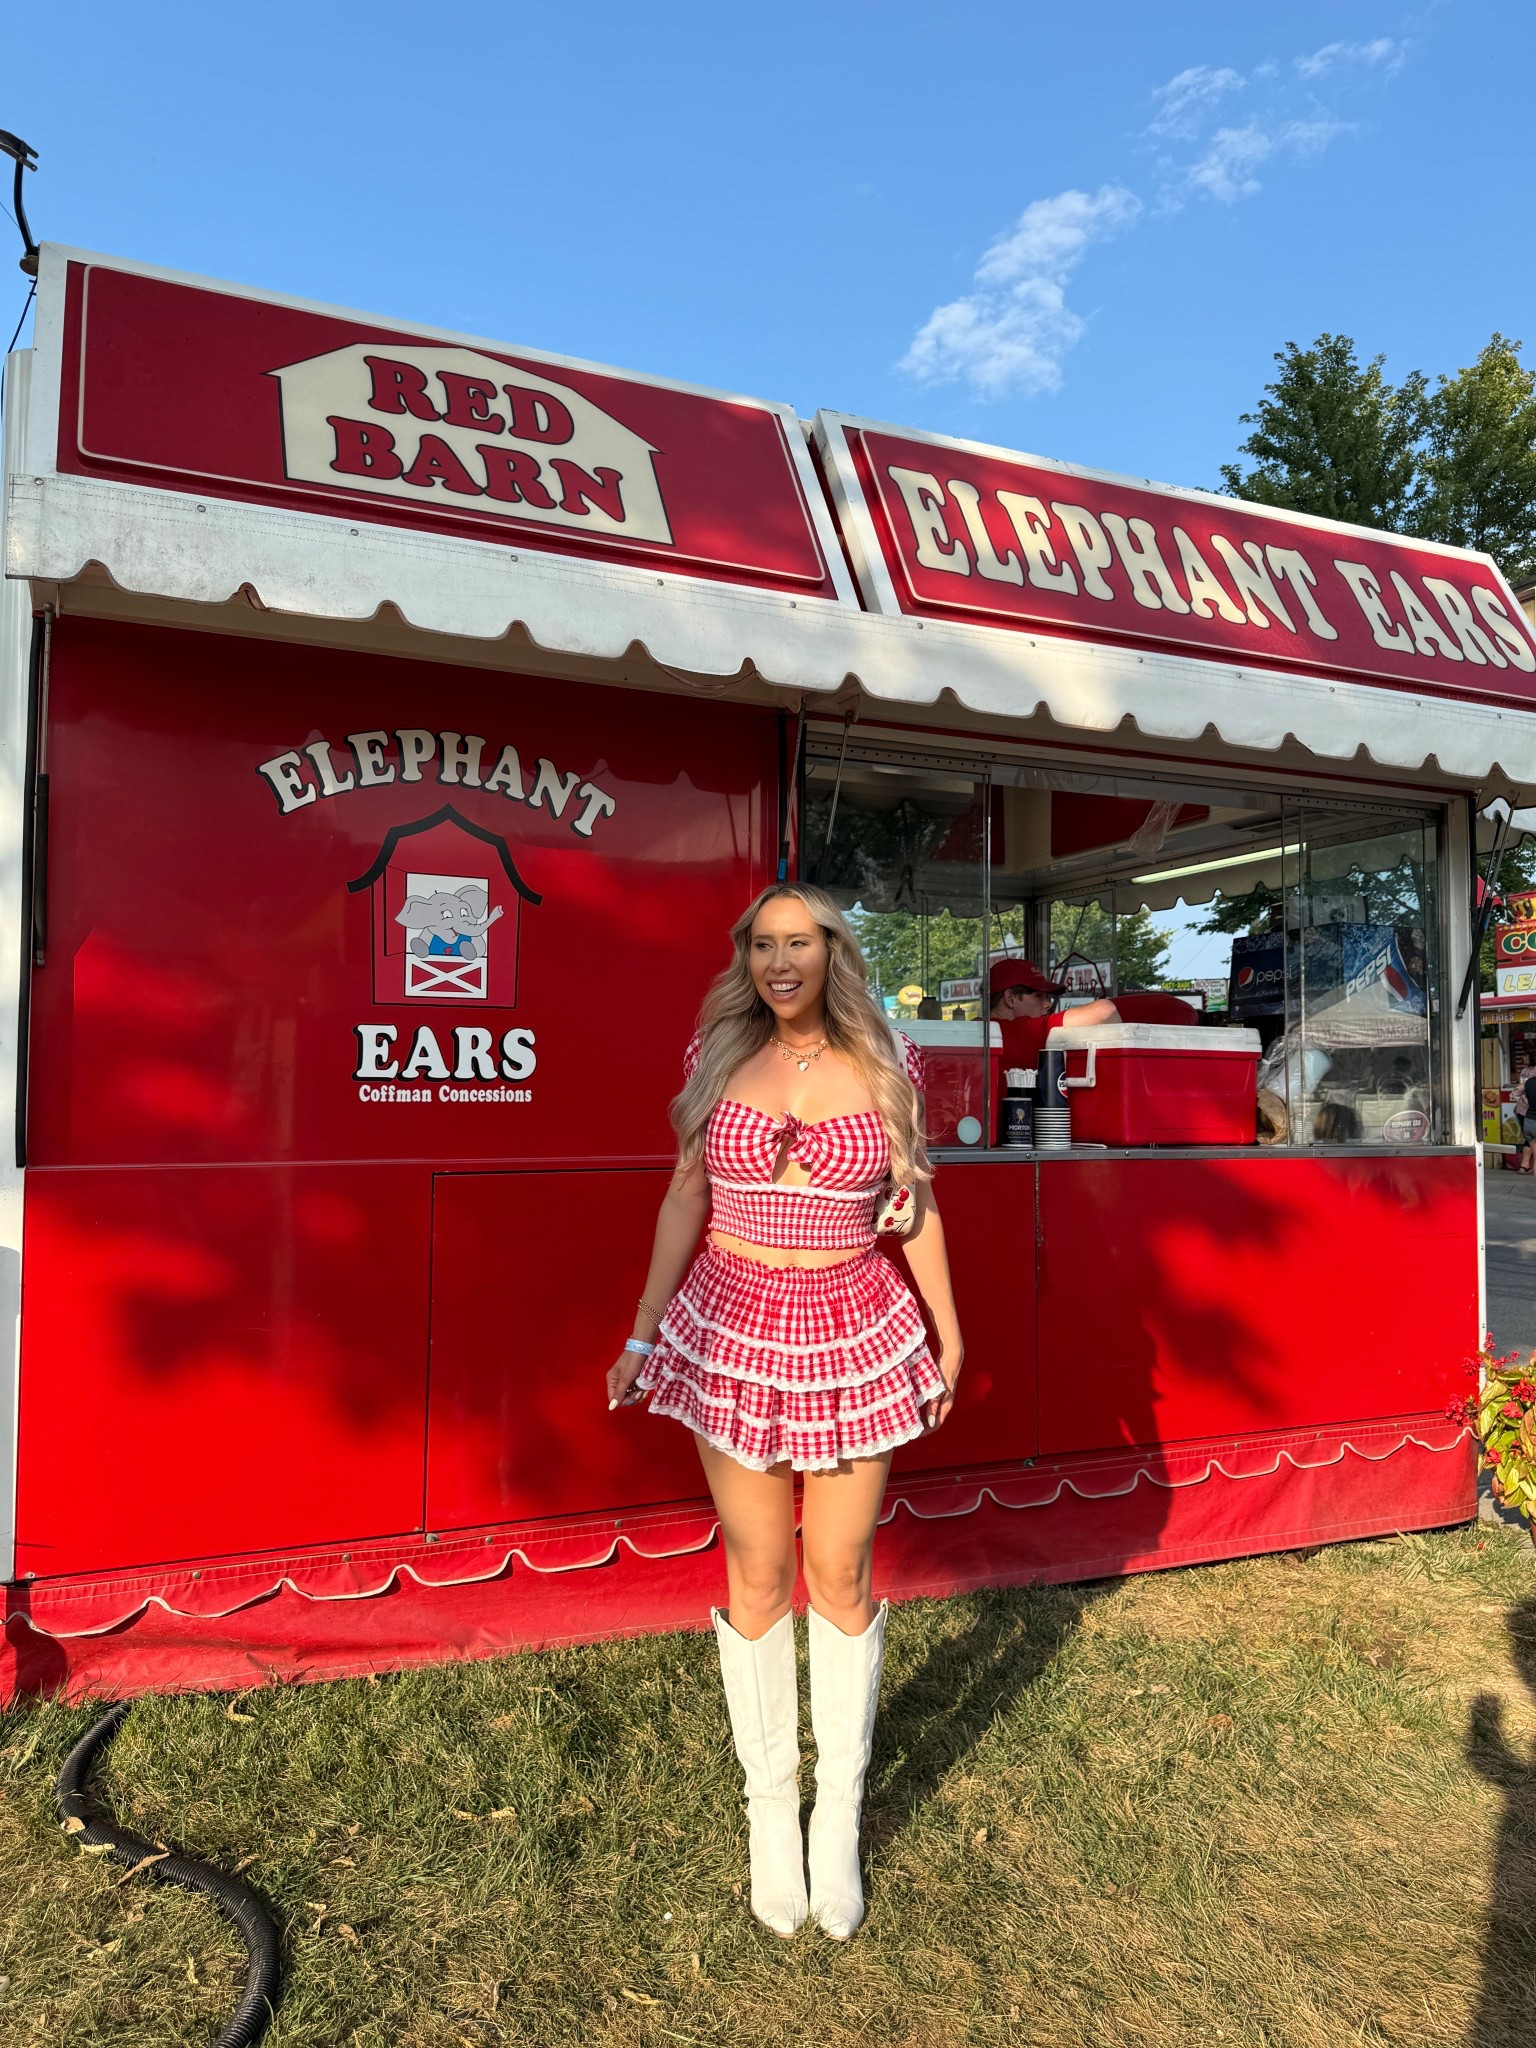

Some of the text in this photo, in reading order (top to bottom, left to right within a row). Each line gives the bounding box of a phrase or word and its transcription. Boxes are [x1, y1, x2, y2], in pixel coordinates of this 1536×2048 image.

[364, 355, 575, 446] RED
[326, 415, 626, 523] BARN
[888, 465, 1536, 674] ELEPHANT EARS
[256, 728, 616, 838] ELEPHANT
[1346, 944, 1393, 1003] PEPSI
[352, 1023, 538, 1083] EARS
[1491, 1011, 1515, 1022] FRIES
[359, 1085, 533, 1103] Coffman Concessions
